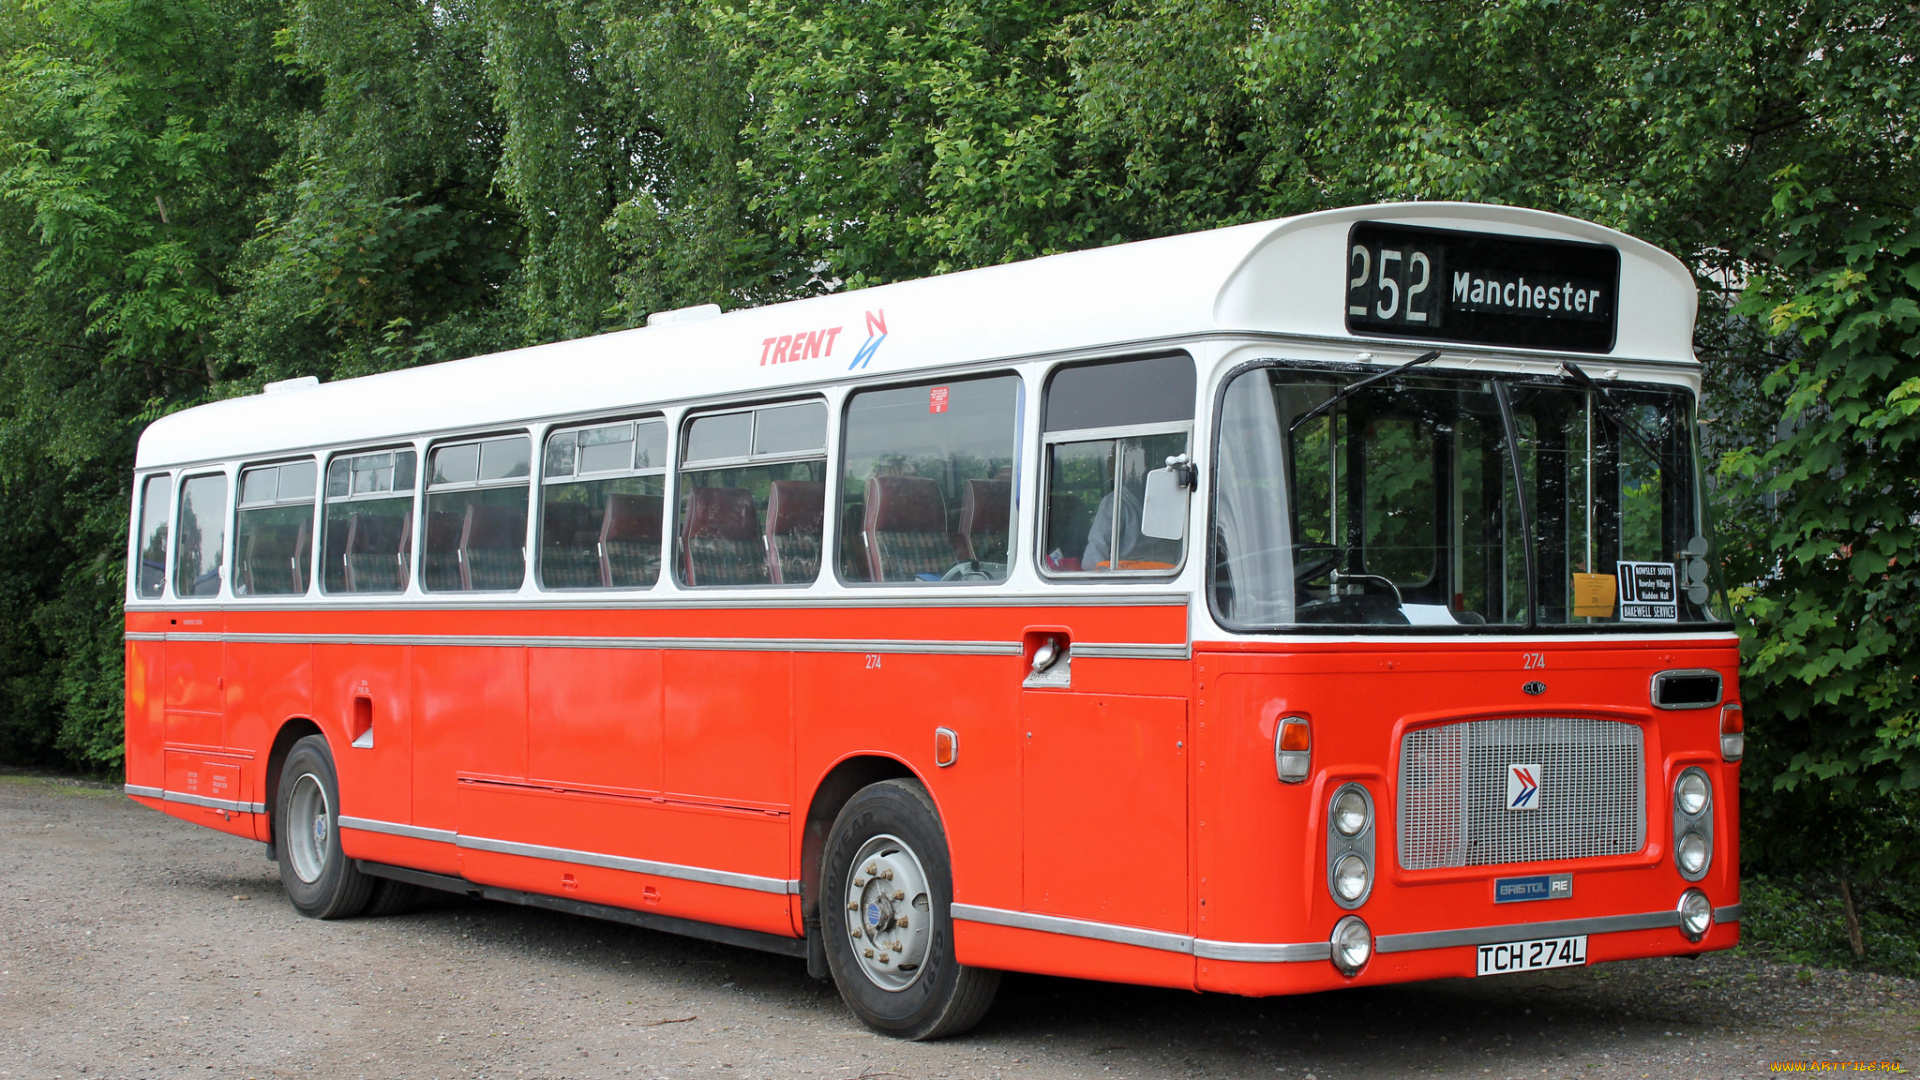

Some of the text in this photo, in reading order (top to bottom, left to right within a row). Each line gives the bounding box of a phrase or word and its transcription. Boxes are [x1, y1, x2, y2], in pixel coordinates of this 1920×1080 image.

[1349, 244, 1600, 322] 252 Manchester
[760, 326, 843, 366] TRENT
[1635, 566, 1672, 576] ROWSLEY SOUTH
[1656, 580, 1670, 590] Village
[1641, 591, 1659, 599] Haddon
[1624, 605, 1675, 618] BAKEWELL SERVICE
[865, 654, 882, 669] 274
[1522, 652, 1545, 669] 274
[1500, 880, 1568, 896] BRISTOL RE
[1480, 939, 1585, 972] TCH 274L
